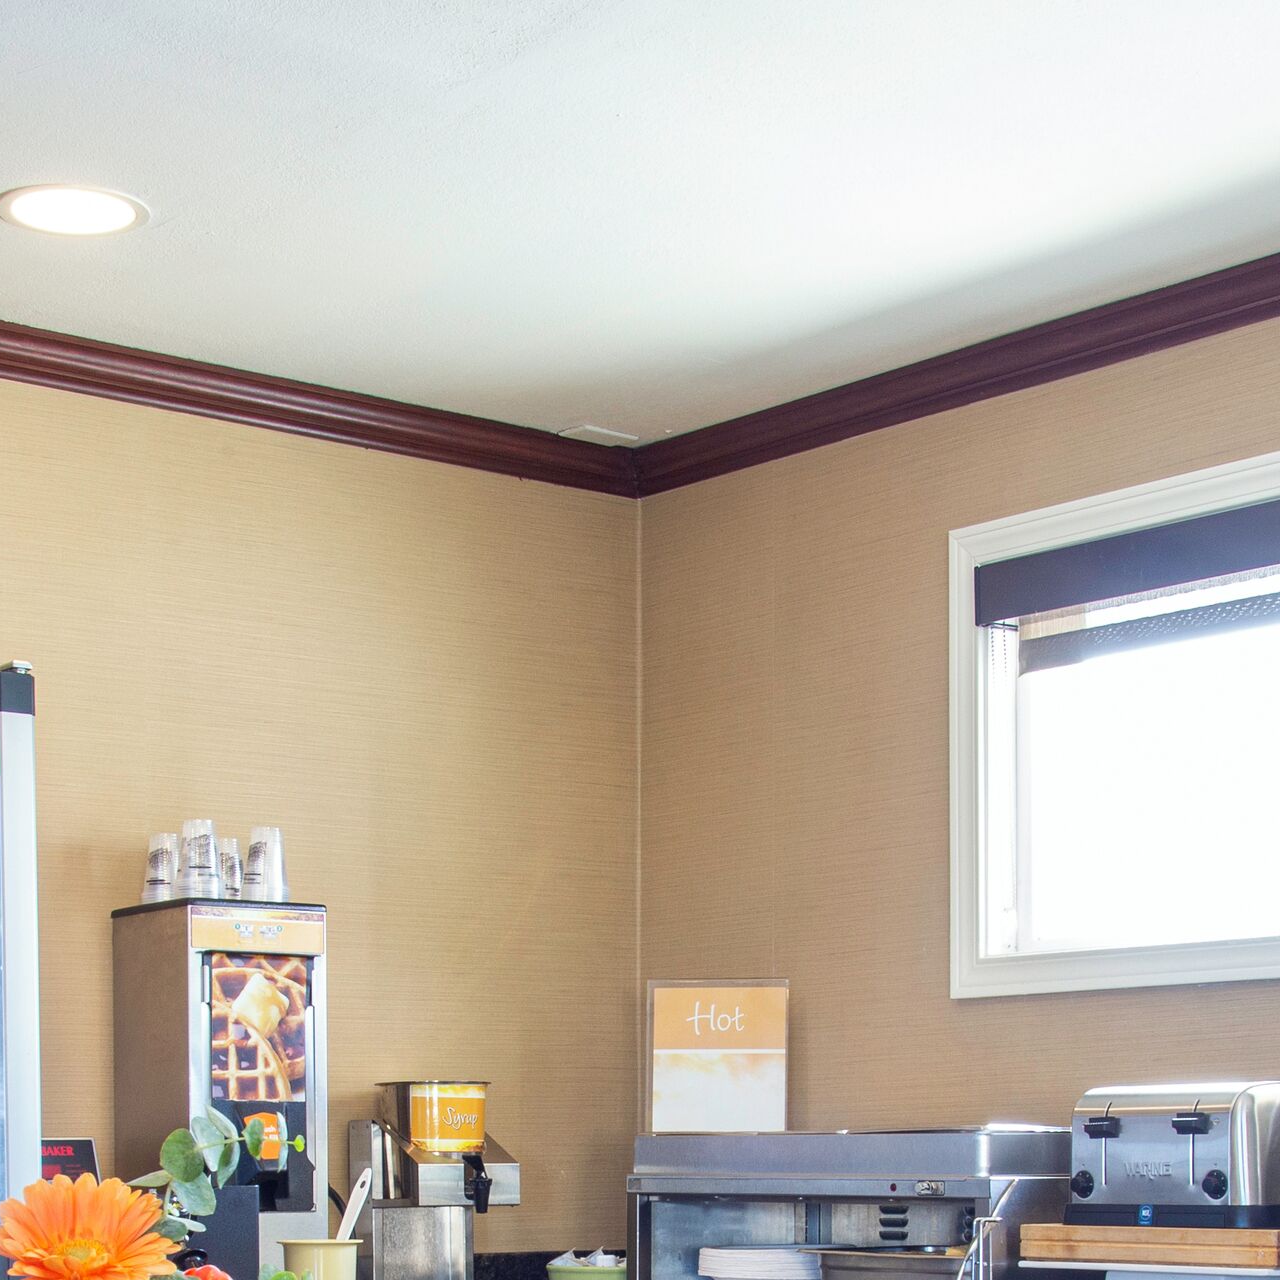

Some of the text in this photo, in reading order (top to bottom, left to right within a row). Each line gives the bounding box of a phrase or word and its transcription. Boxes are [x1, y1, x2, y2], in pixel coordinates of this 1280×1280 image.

[686, 1001, 745, 1036] Hot
[441, 1106, 478, 1130] Syrup
[1123, 1161, 1172, 1181] WARING
